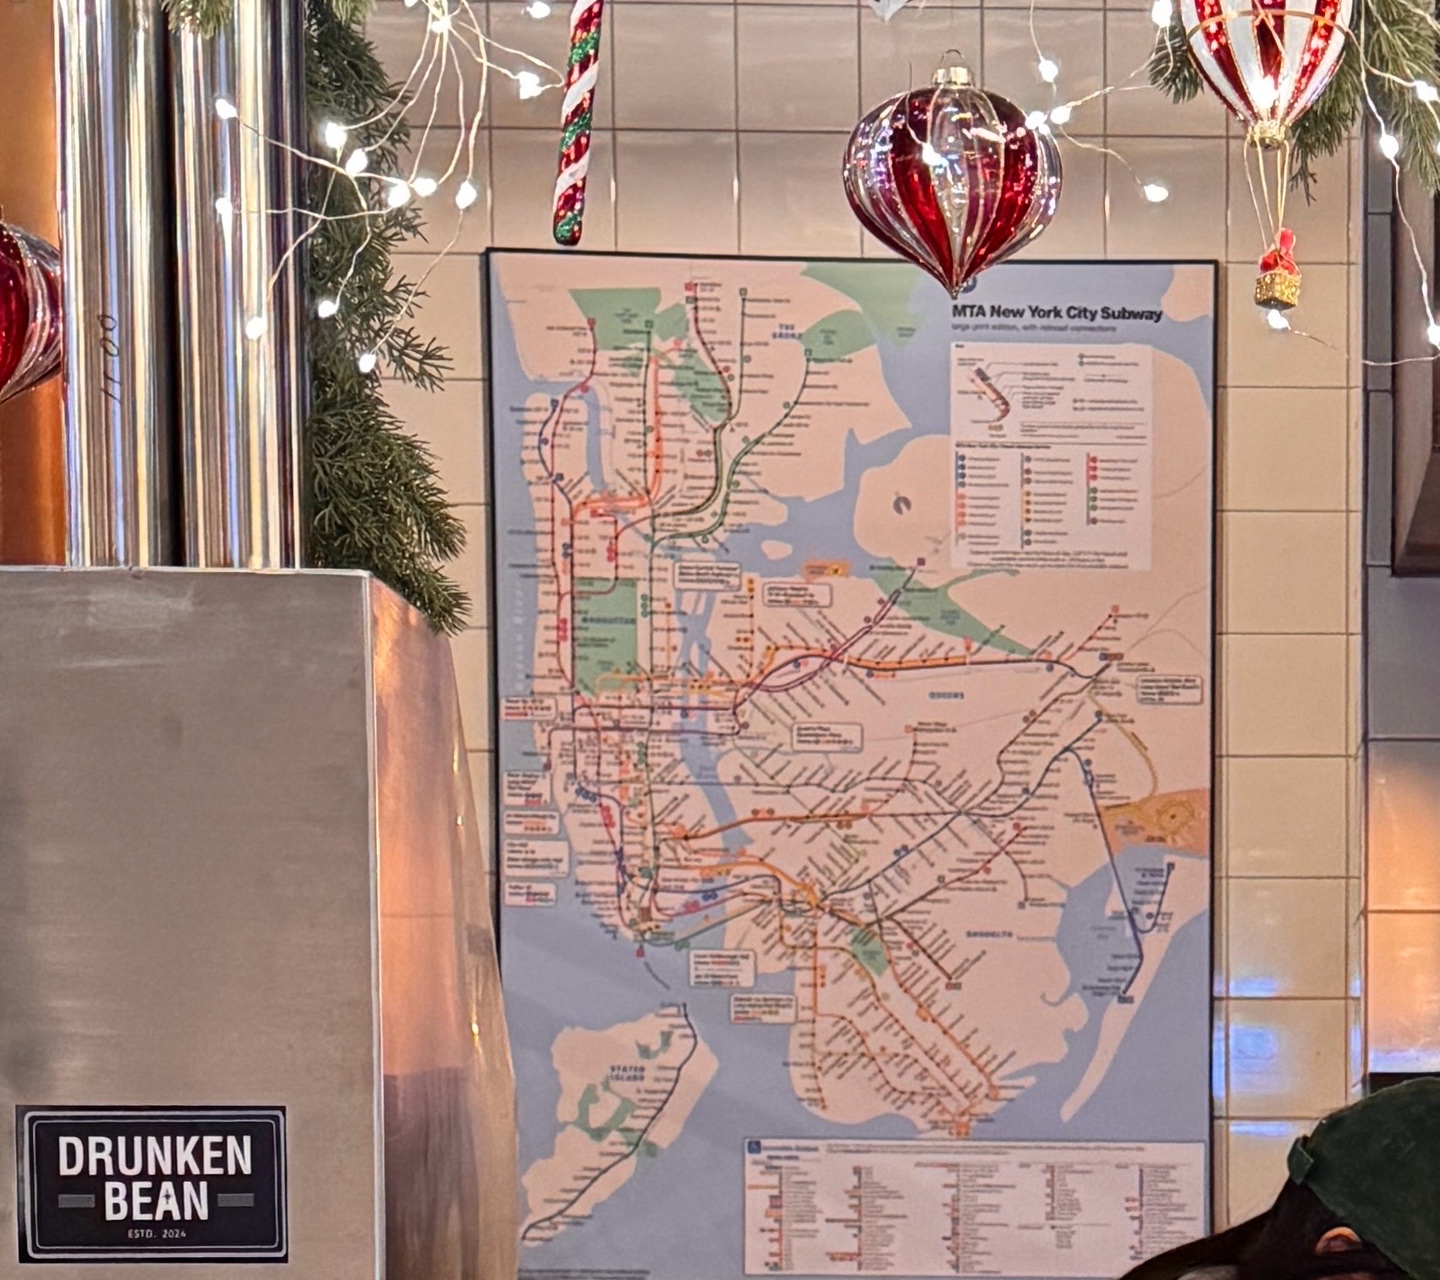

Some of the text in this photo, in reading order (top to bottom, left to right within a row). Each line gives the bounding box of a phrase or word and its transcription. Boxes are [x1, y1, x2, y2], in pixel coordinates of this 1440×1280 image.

[952, 304, 1163, 323] MTA New York City Subway
[58, 1135, 252, 1176] DRUNKEN
[104, 1180, 209, 1221] BEAN
[127, 1229, 187, 1239] ESTD. 2024
